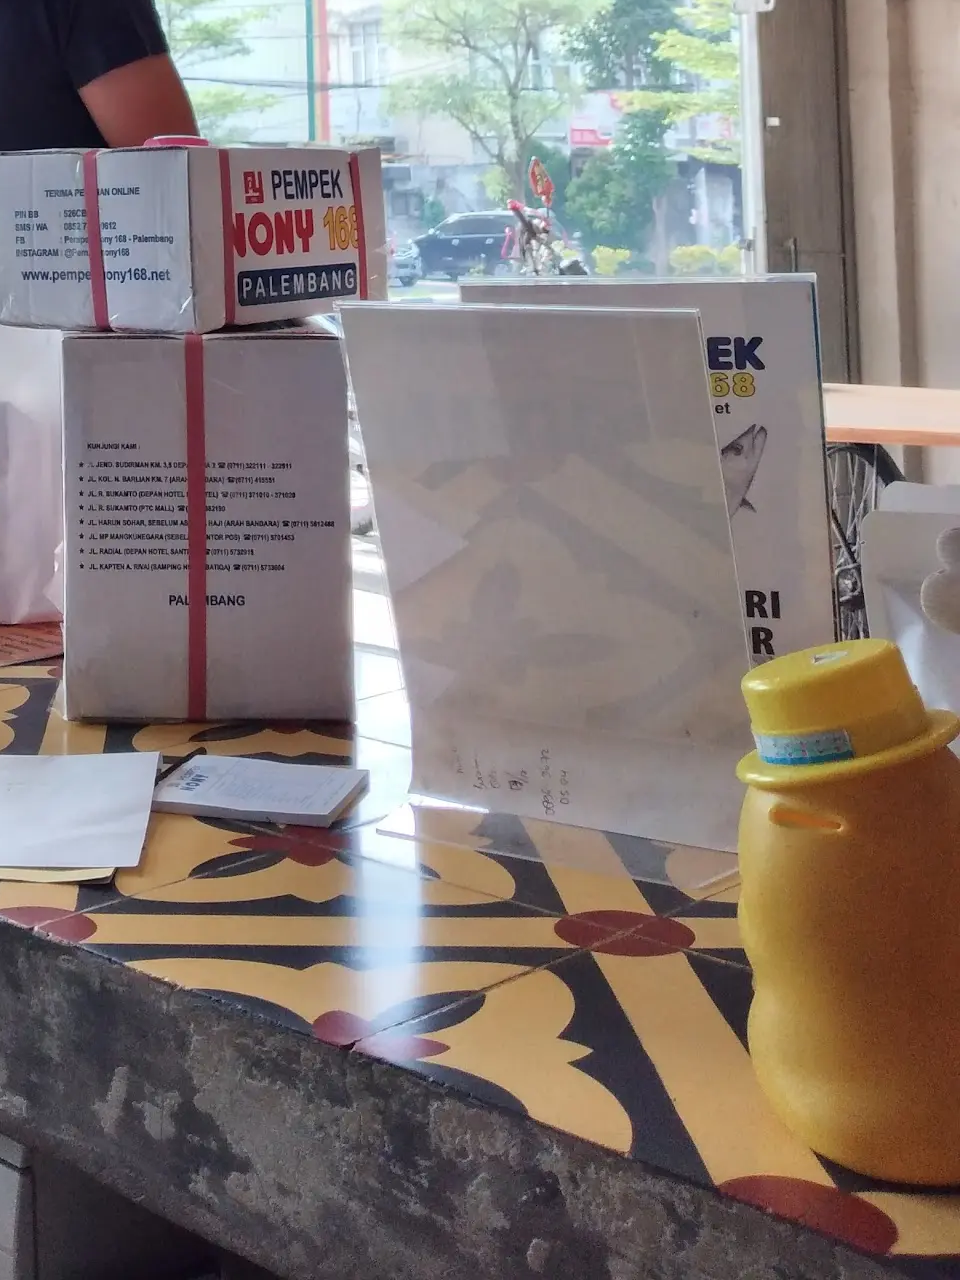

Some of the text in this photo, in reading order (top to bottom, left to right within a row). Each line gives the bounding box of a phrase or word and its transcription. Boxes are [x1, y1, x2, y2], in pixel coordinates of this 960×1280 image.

[271, 169, 343, 200] PEMPEK
[45, 186, 140, 198] TERIMA PEAN ONLINE
[28, 211, 39, 219] BB
[36, 223, 48, 231] WA
[232, 209, 314, 257] NONY
[115, 235, 127, 243] 168
[132, 234, 174, 245] Palembang
[16, 249, 59, 258] INSTAGRAM
[21, 268, 171, 284] www.pempeony168.net
[242, 269, 356, 300] PALEMBANG
[169, 594, 246, 607] PALBANG
